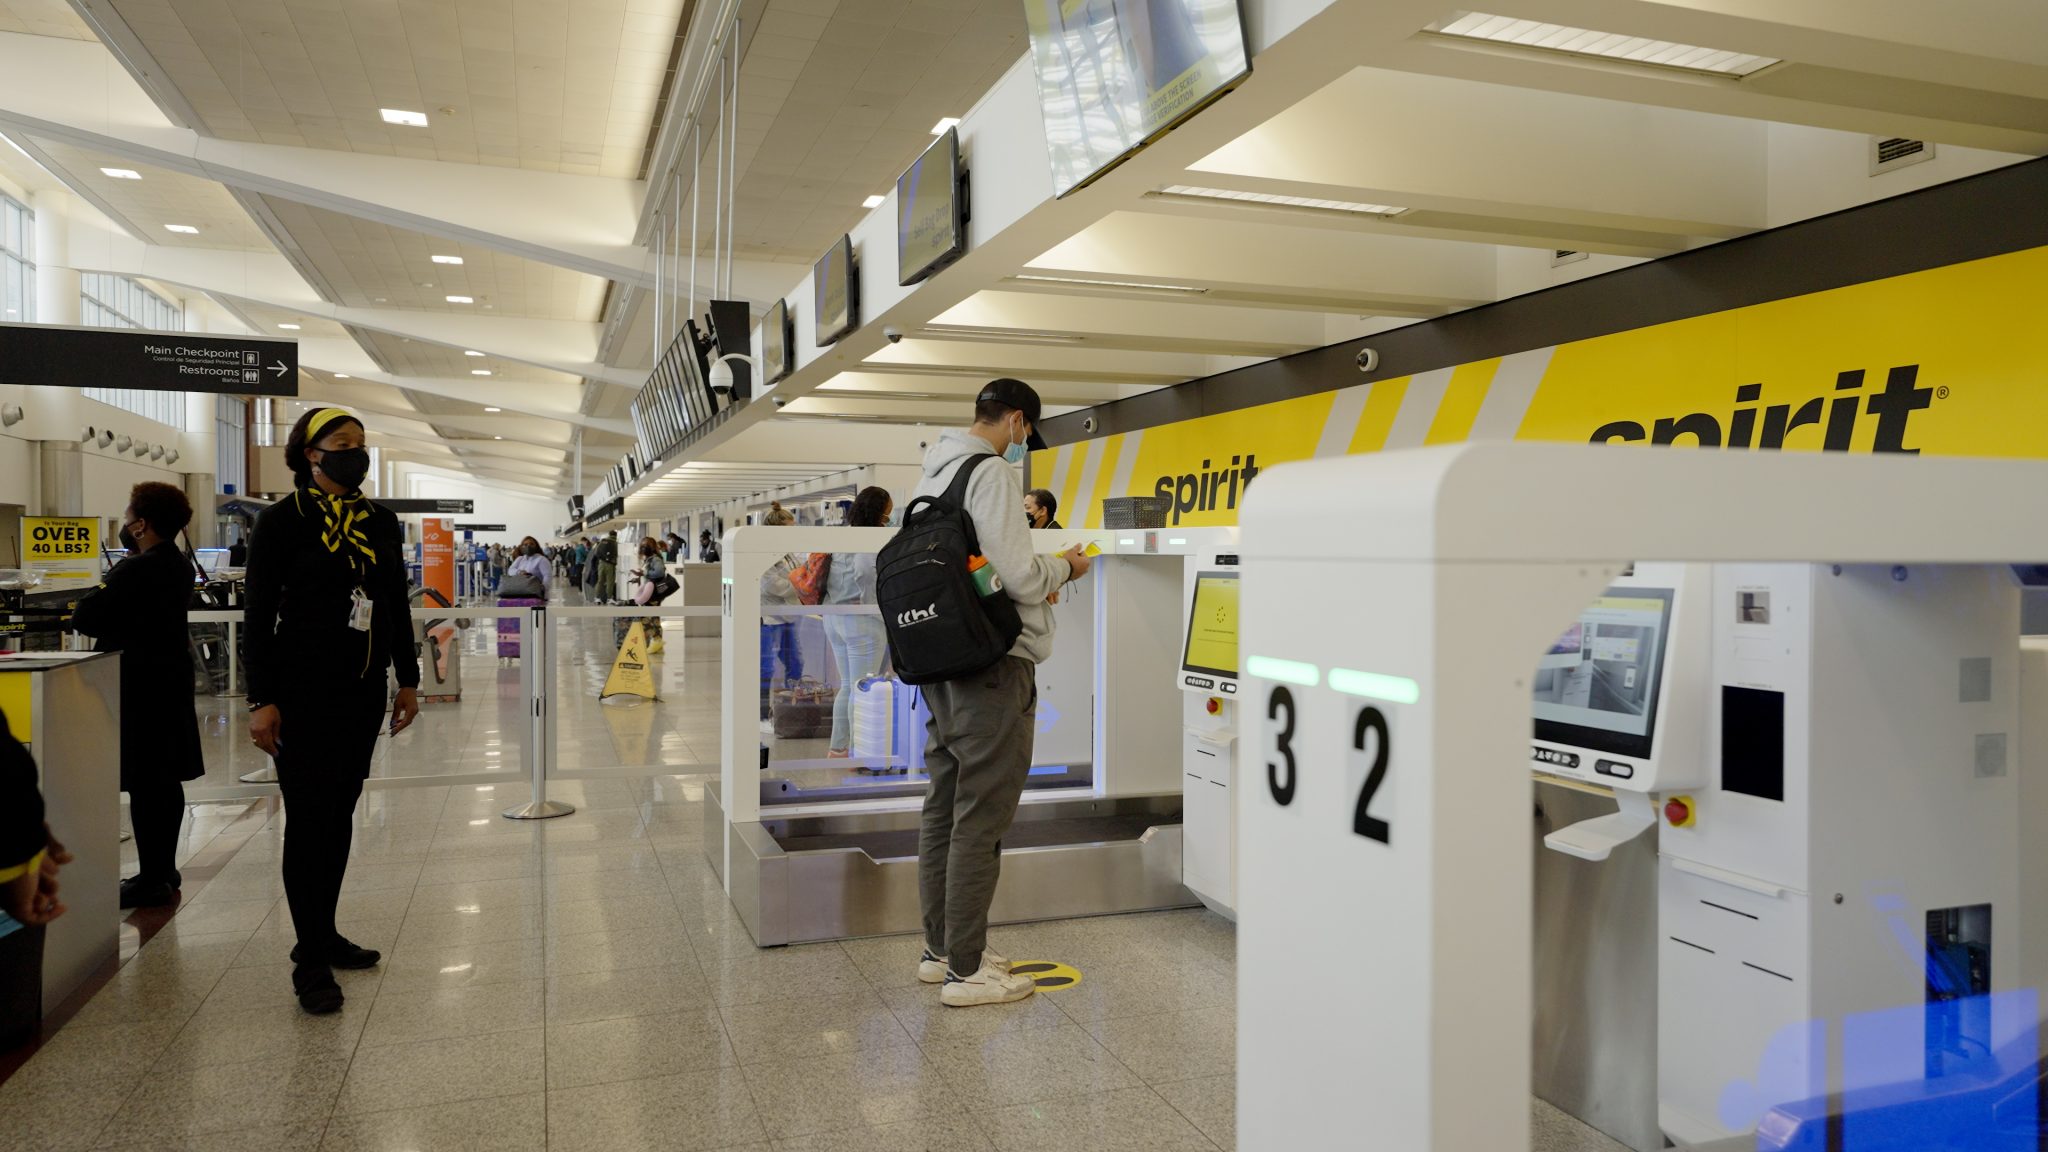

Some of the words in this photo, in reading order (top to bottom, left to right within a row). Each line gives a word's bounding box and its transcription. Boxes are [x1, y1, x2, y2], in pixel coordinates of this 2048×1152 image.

[1168, 85, 1178, 99] THE
[1179, 70, 1202, 89] SCREEN
[144, 345, 172, 355] Main
[175, 347, 240, 358] Checkpoint
[180, 365, 240, 376] Restrooms
[32, 526, 90, 541] OVER
[32, 543, 51, 553] 40
[55, 543, 90, 553] LBS?
[1267, 685, 1297, 807] 3
[1353, 705, 1390, 846] 2
